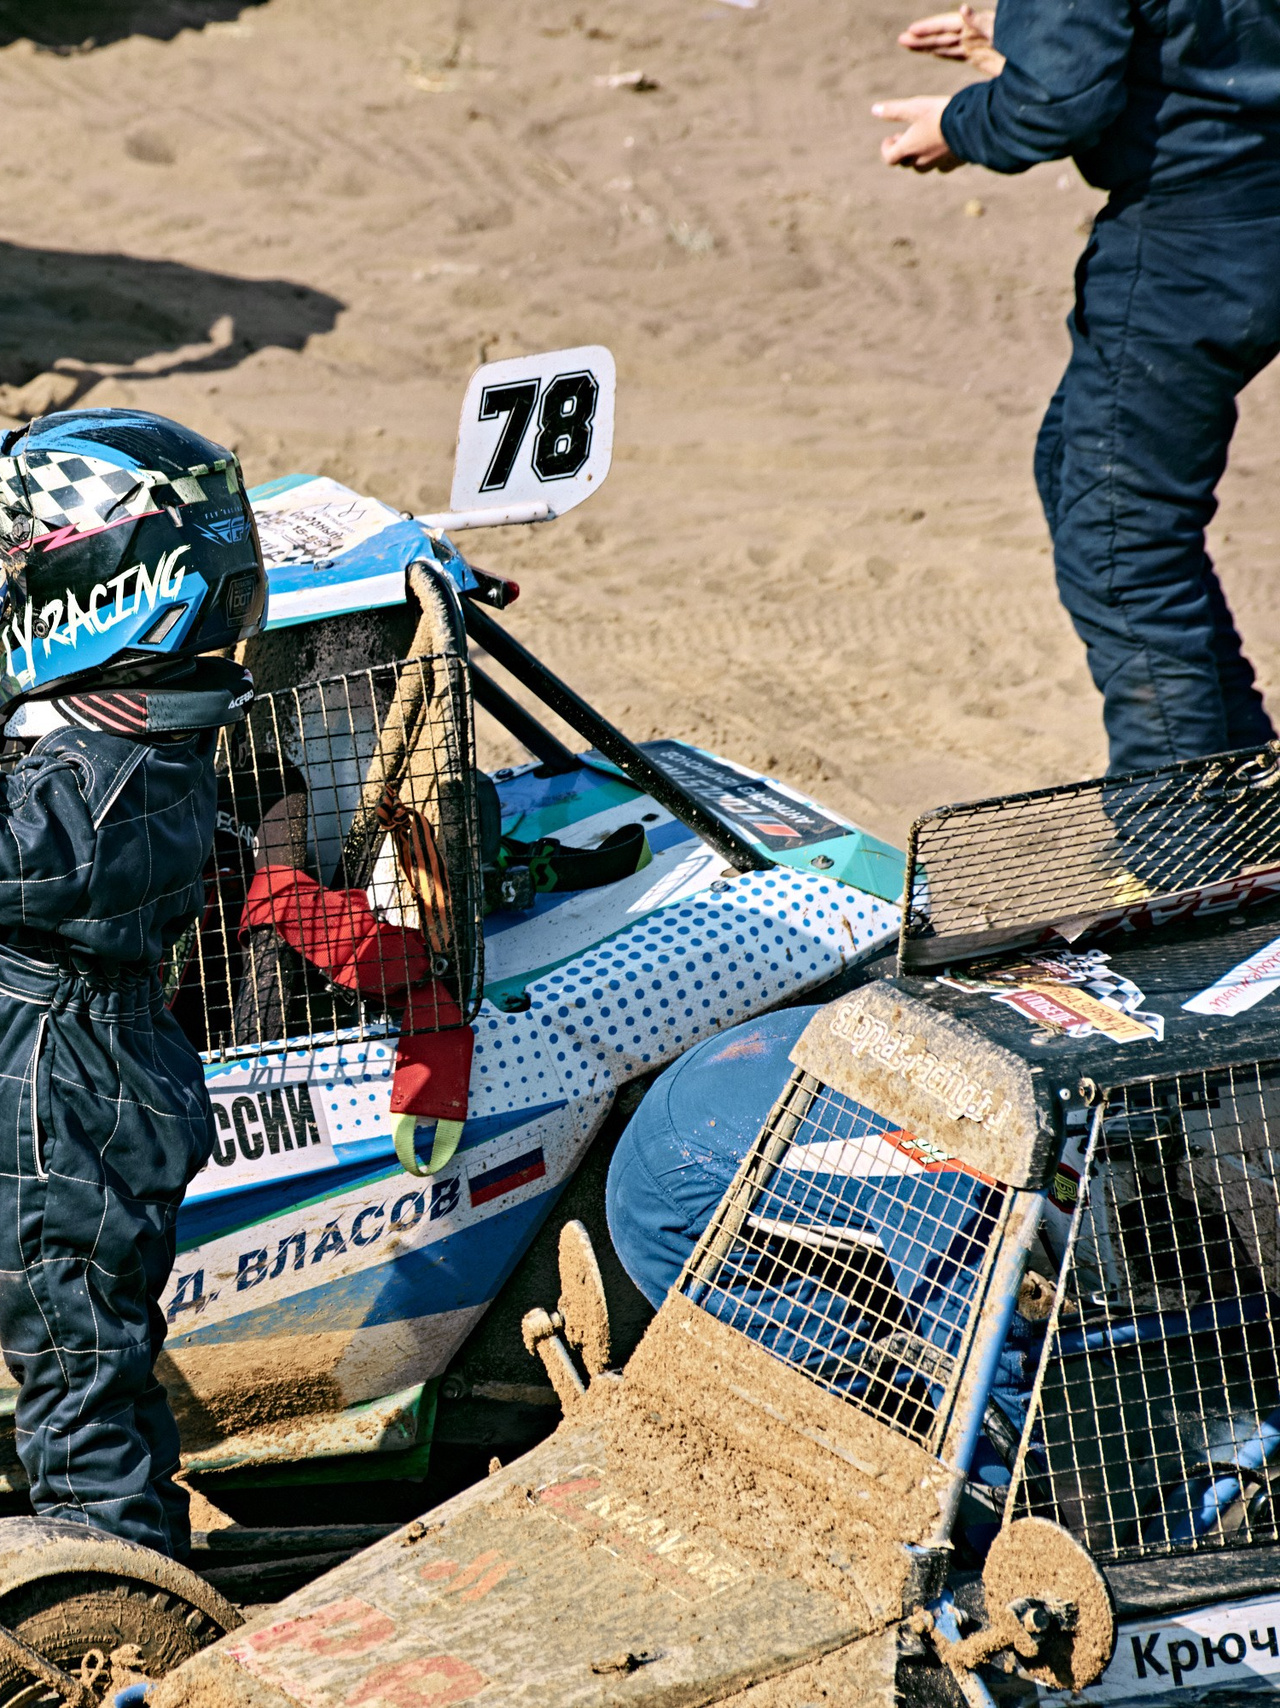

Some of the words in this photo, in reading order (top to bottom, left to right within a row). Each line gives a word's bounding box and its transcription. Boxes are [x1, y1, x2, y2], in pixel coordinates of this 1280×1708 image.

[478, 369, 599, 493] 78
[2, 595, 36, 687] LY
[42, 544, 191, 658] RACING
[211, 1082, 321, 1168] ССИИ
[166, 1264, 221, 1324] Д.
[236, 1173, 463, 1292] ВЛАСОВ
[1131, 1626, 1280, 1687] Крюч
